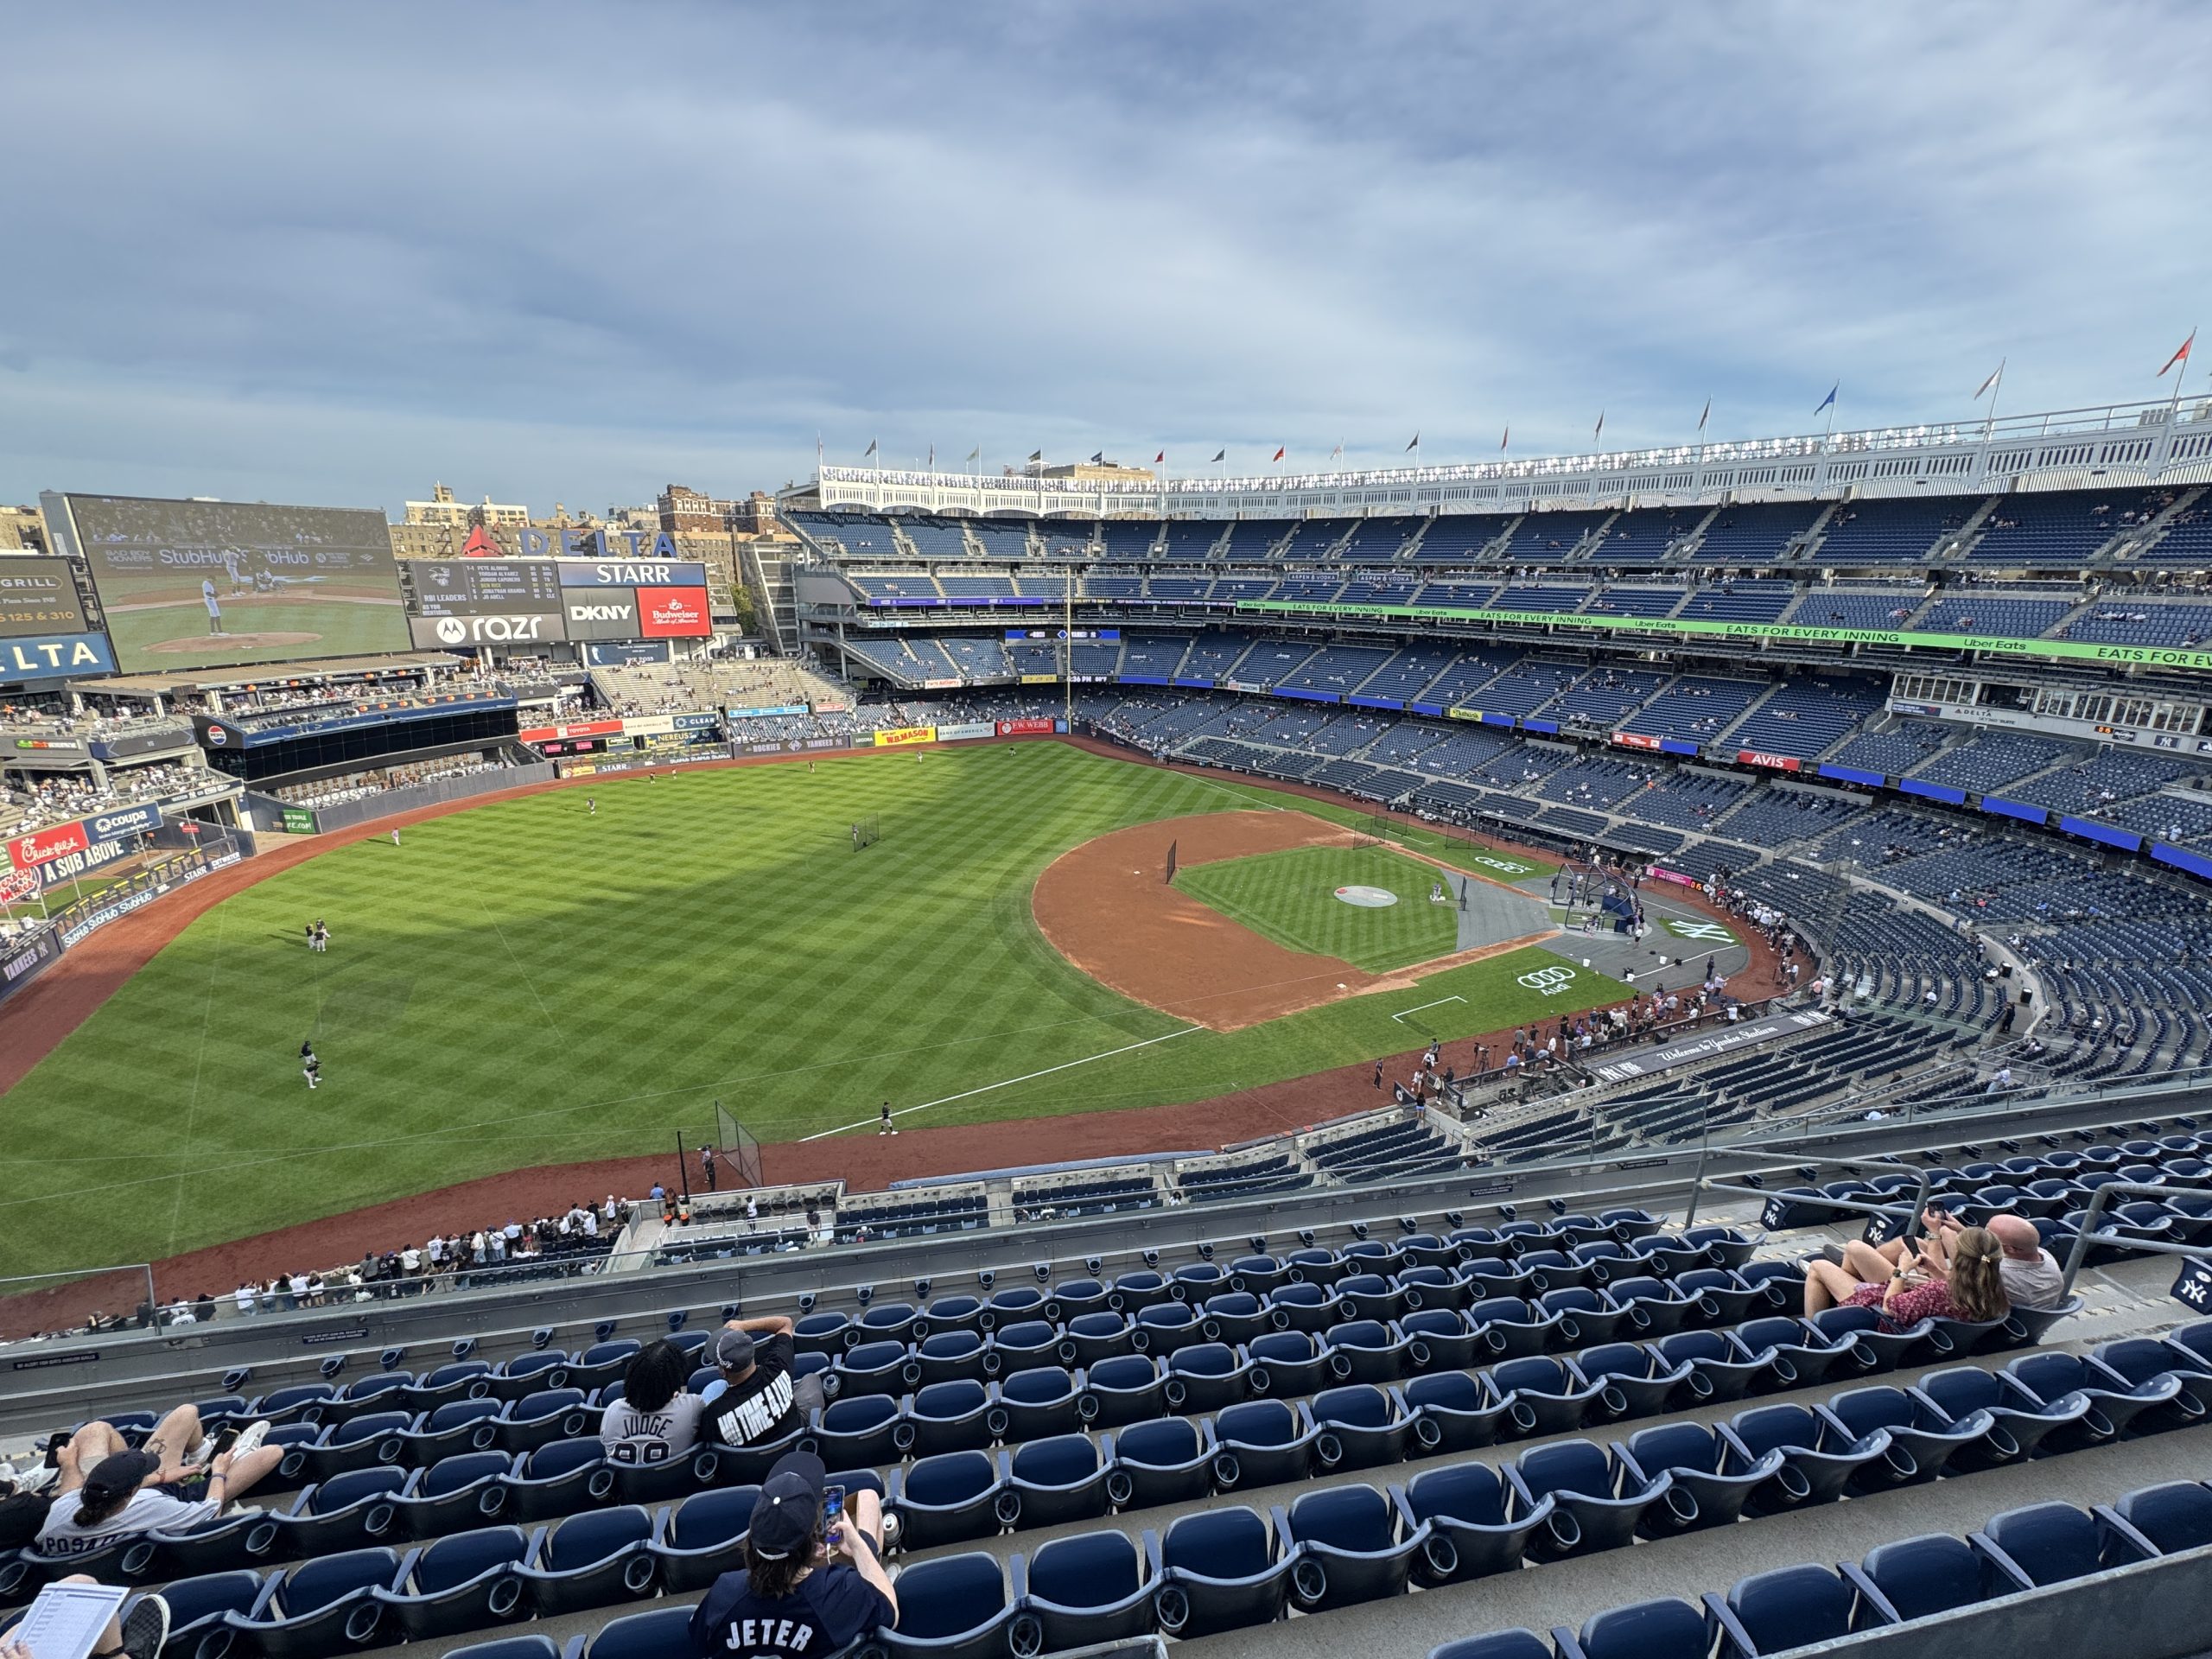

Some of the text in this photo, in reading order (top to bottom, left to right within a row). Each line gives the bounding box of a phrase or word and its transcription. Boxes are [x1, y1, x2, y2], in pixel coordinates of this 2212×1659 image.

[520, 528, 677, 557] DELTA
[1, 578, 56, 588] GRILL
[596, 564, 671, 583] STARR
[36, 612, 48, 620] &
[570, 605, 632, 620] DKNY
[652, 610, 699, 619] Budweiser
[1525, 613, 1554, 622] EVERY
[1555, 616, 1592, 625] INNING
[472, 615, 543, 641] razr
[1726, 626, 1899, 643] EATS FOR EVERY INNING
[1964, 638, 2026, 650] Uber Eats
[2098, 648, 2144, 660] EATS
[2152, 652, 2188, 664] FOR
[1963, 709, 1992, 717] DELTA
[658, 733, 689, 741] NEREUS
[807, 739, 833, 748] YANKEES
[753, 743, 781, 752] ROCKIES
[1751, 753, 1784, 767] AVIS
[111, 809, 148, 828] coupa
[21, 839, 79, 862] Chick-fil-A
[86, 840, 124, 866] ABOVE
[44, 849, 85, 883] A SUB
[183, 866, 207, 882] STARR
[119, 892, 152, 912] StubHub
[88, 909, 118, 931] StubHub
[64, 925, 89, 949] StubHub
[3, 949, 38, 982] YANKEES
[1540, 983, 1573, 997] Audi
[1657, 1046, 1701, 1061] Welcome
[1707, 1035, 1742, 1052] Yankee
[1741, 1027, 1778, 1039] Stadium
[2181, 1279, 2208, 1303] NY
[734, 1391, 775, 1441] TIME
[622, 1414, 673, 1440] JUDGE
[726, 1619, 813, 1651] JETER
